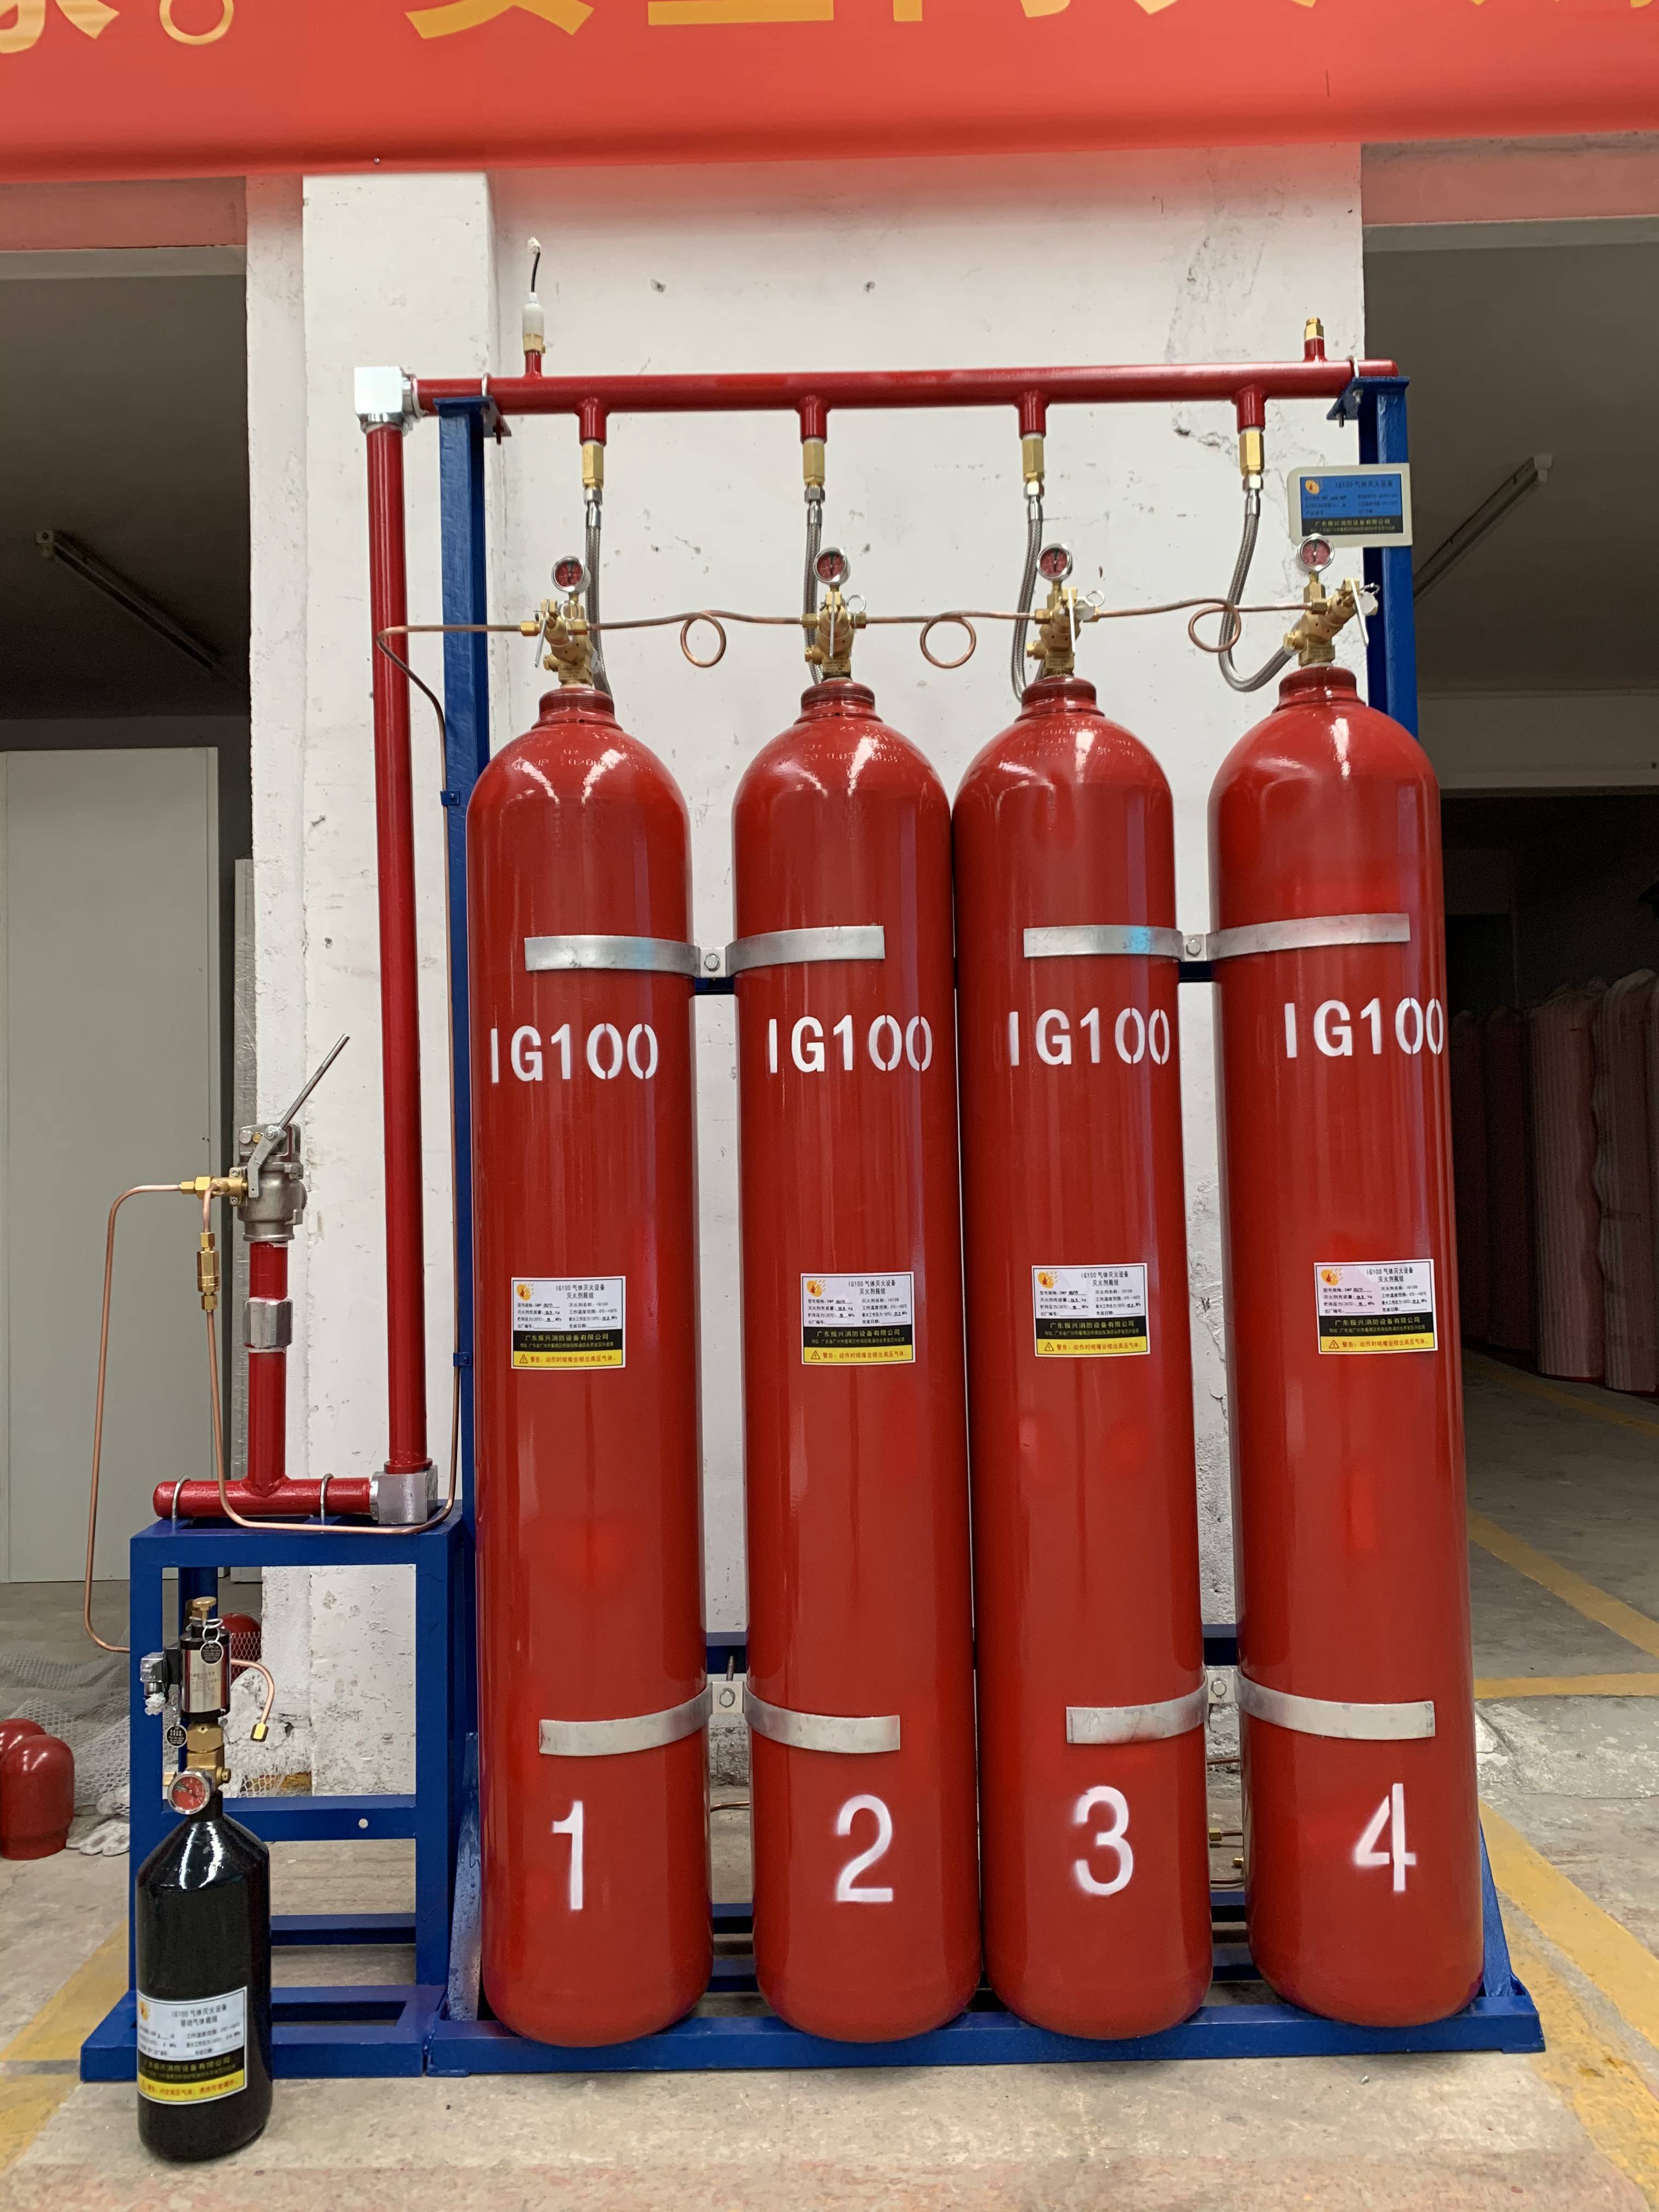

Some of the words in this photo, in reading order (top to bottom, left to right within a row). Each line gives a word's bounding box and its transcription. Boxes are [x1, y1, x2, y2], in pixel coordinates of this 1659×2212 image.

[491, 1024, 658, 1083] IG100
[769, 1015, 932, 1073] IG100
[1008, 1008, 1170, 1065] IG100
[1284, 997, 1444, 1058] IG100
[1050, 1321, 1134, 1329] 广东振兴消防设备有限公司
[1335, 1317, 1420, 1326] 广东振兴消防设备有限公司
[552, 1801, 583, 1910] 1
[836, 1794, 893, 1903] 2
[1073, 1786, 1133, 1895] 3
[1352, 1783, 1416, 1892] 4
